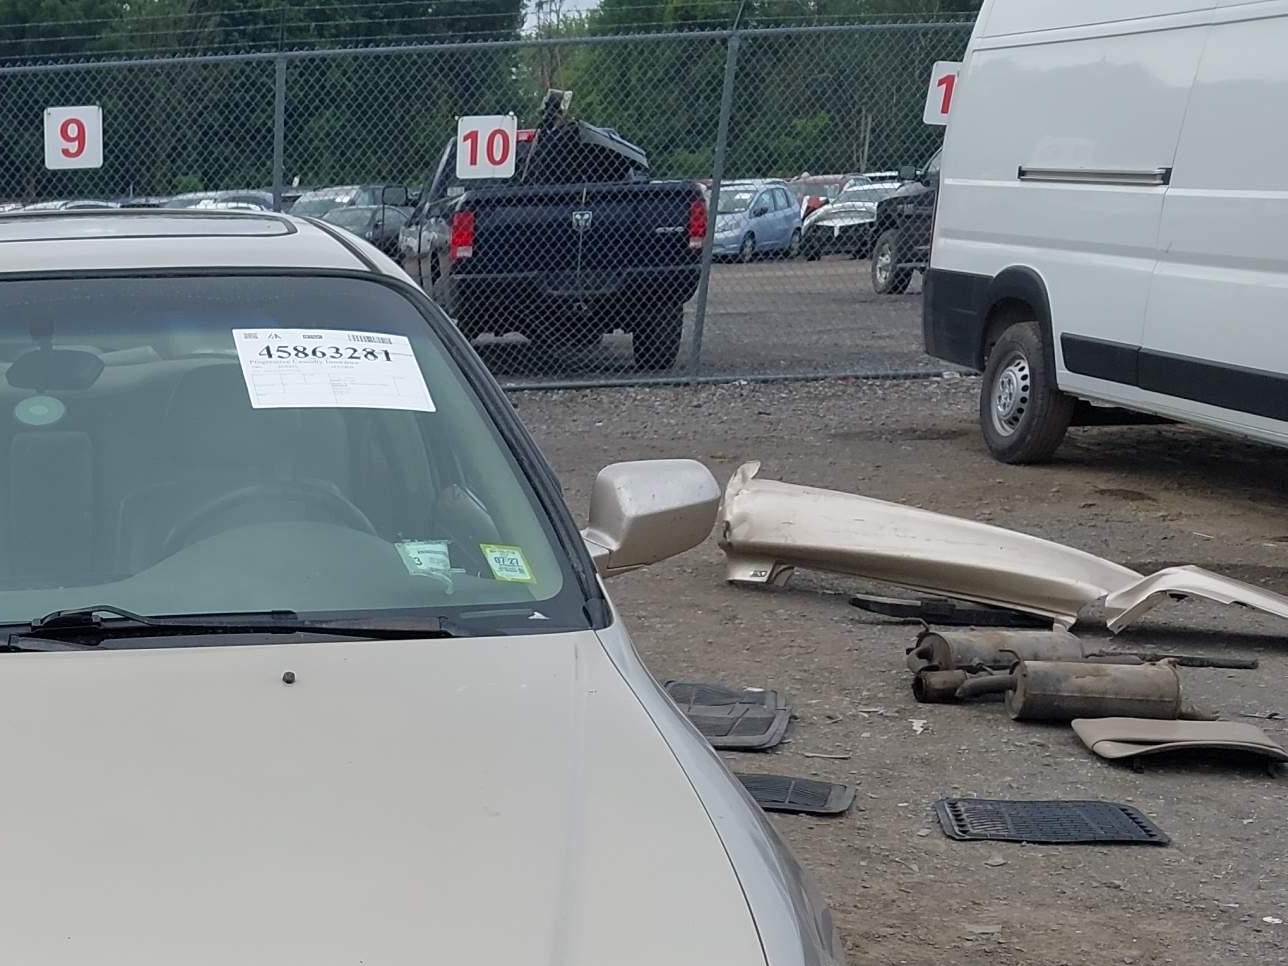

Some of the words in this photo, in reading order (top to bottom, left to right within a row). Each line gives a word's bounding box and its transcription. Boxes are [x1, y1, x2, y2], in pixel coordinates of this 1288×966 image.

[937, 74, 956, 114] 1
[59, 117, 87, 159] 9
[462, 128, 511, 167] 10
[258, 344, 394, 362] 45863281
